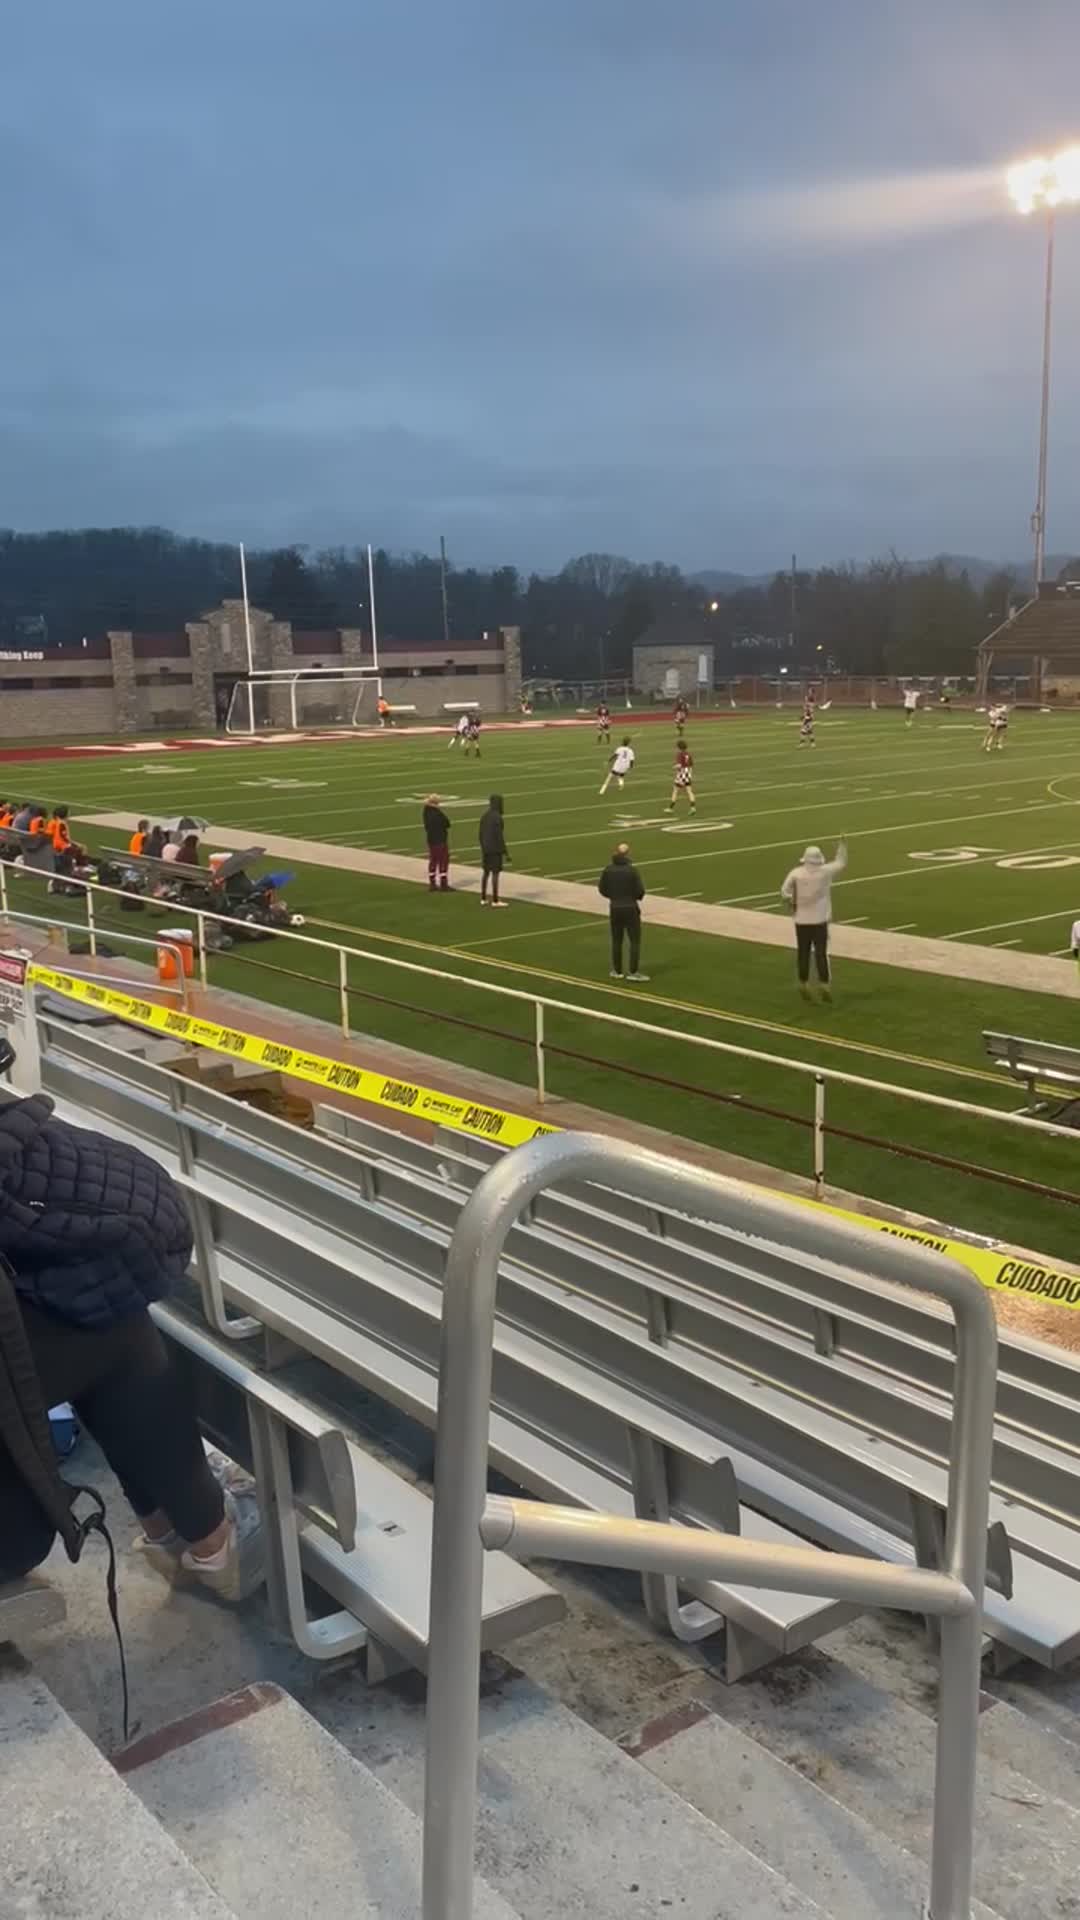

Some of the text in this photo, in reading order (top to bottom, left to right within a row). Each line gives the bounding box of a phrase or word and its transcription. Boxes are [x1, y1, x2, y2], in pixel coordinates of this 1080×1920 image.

[907, 845, 1080, 869] 50
[219, 1030, 247, 1051] CAUTION
[262, 1044, 293, 1067] CUIDADO
[327, 1064, 362, 1089] CAUTION
[380, 1081, 418, 1107] CUIDADO
[462, 1106, 505, 1135] CAUTION
[996, 1262, 1080, 1303] CUIDADO
